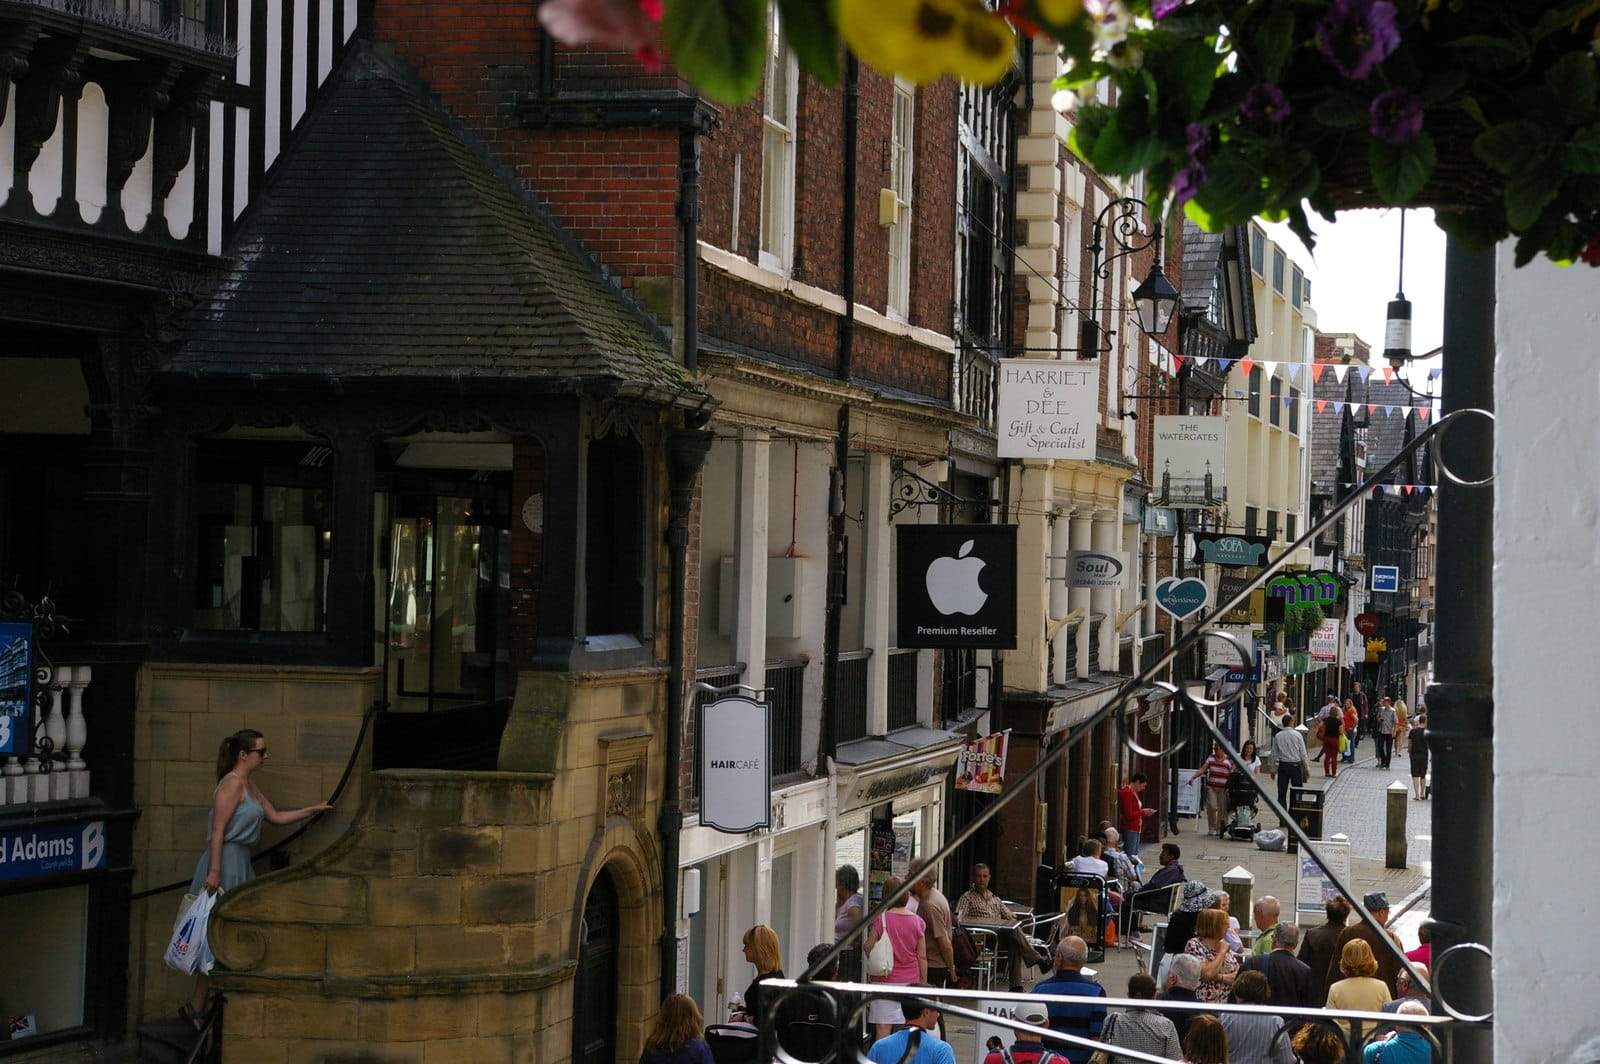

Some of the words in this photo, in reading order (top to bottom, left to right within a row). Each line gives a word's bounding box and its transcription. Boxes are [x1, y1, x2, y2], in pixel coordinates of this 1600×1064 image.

[1006, 369, 1092, 386] HARRIET
[1043, 387, 1054, 398] &
[1027, 400, 1070, 415] DEE
[1008, 420, 1032, 437] Gift
[1036, 424, 1045, 434] &
[1050, 421, 1079, 435] Card
[1026, 435, 1085, 452] Specialist
[1159, 433, 1218, 441] WATERGATES
[1220, 539, 1243, 552] SOFA
[1076, 561, 1109, 573] Soul
[917, 626, 958, 635] Premium
[960, 626, 998, 636] Reseller
[961, 751, 1002, 767] Forte's
[11, 834, 74, 862] Adams
